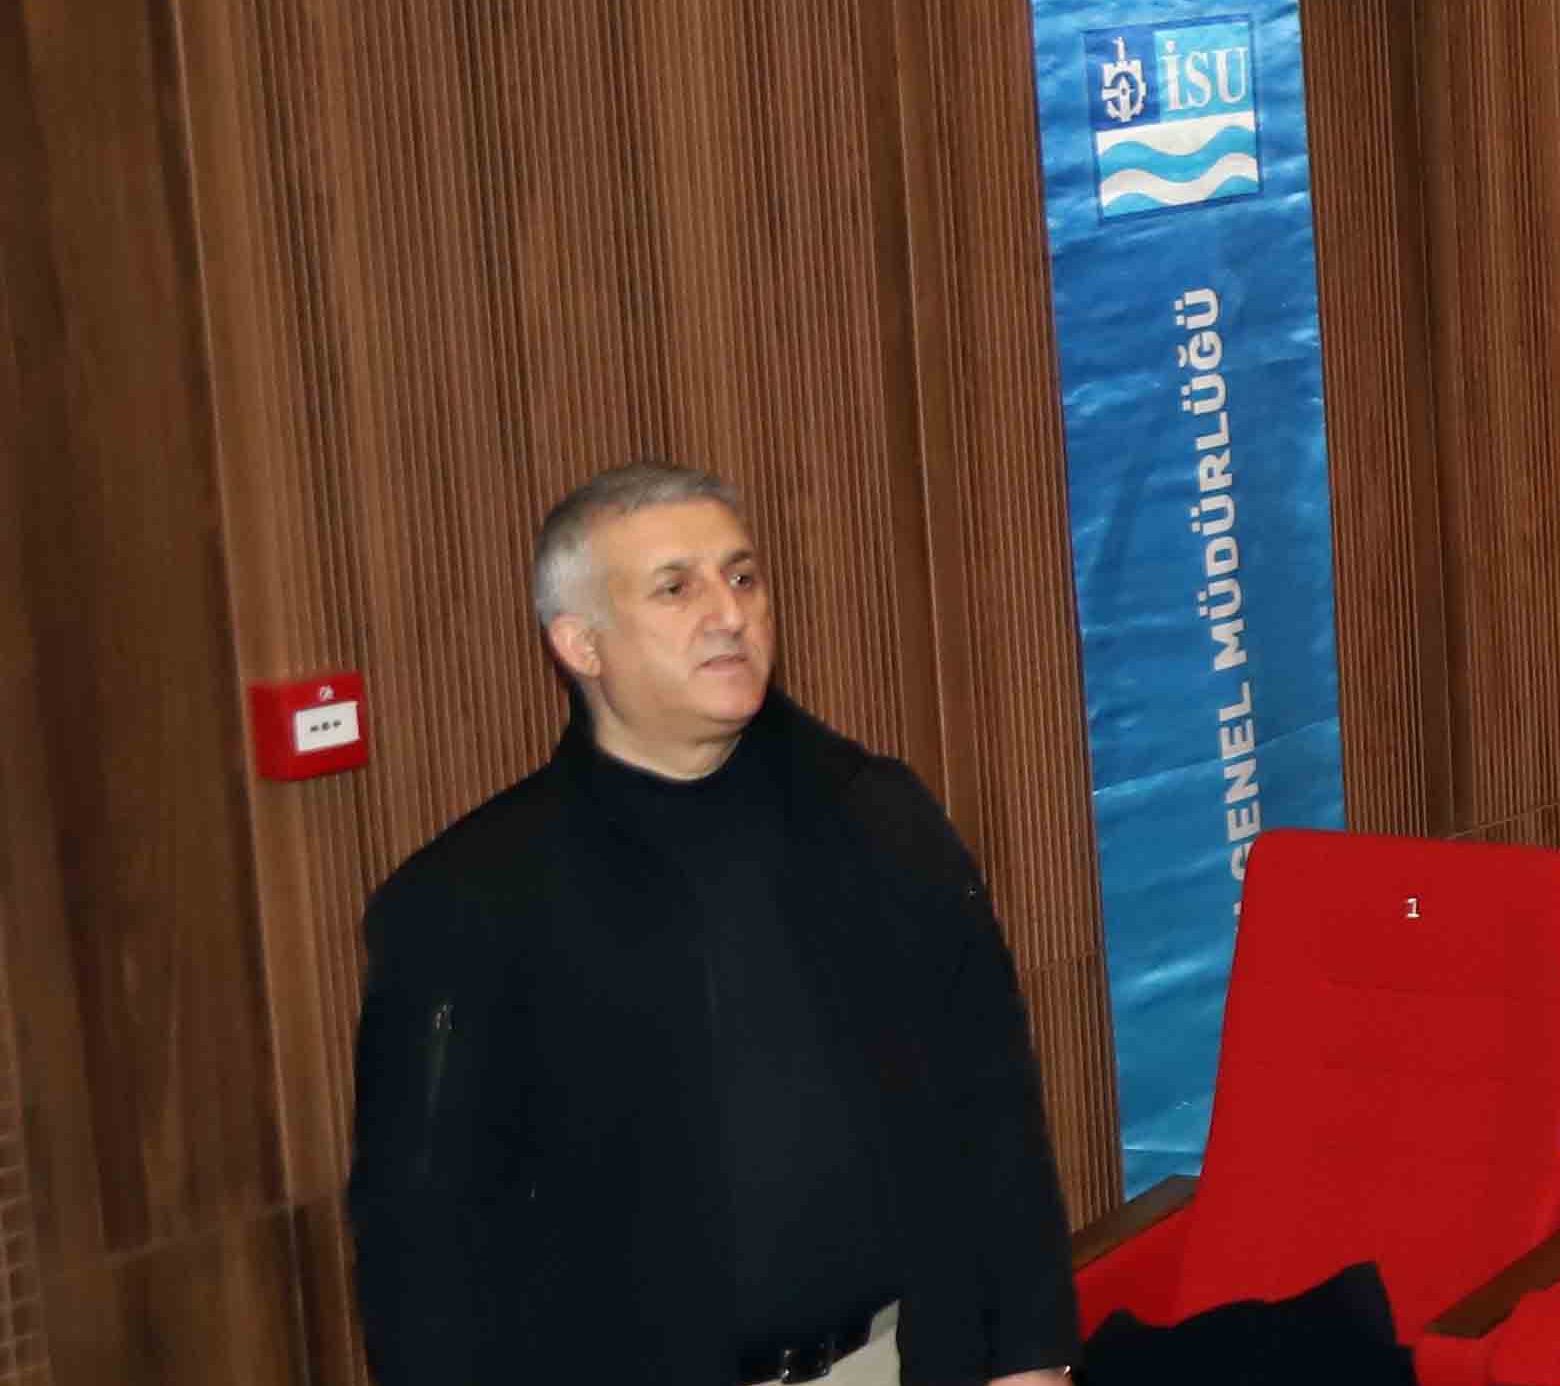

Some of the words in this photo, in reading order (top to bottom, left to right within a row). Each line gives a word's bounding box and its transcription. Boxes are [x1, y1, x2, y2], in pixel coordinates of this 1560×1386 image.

[1164, 39, 1249, 112] İSU
[1174, 287, 1248, 671] MÜDÜRLÜĞÜ
[1407, 897, 1420, 918] 1
